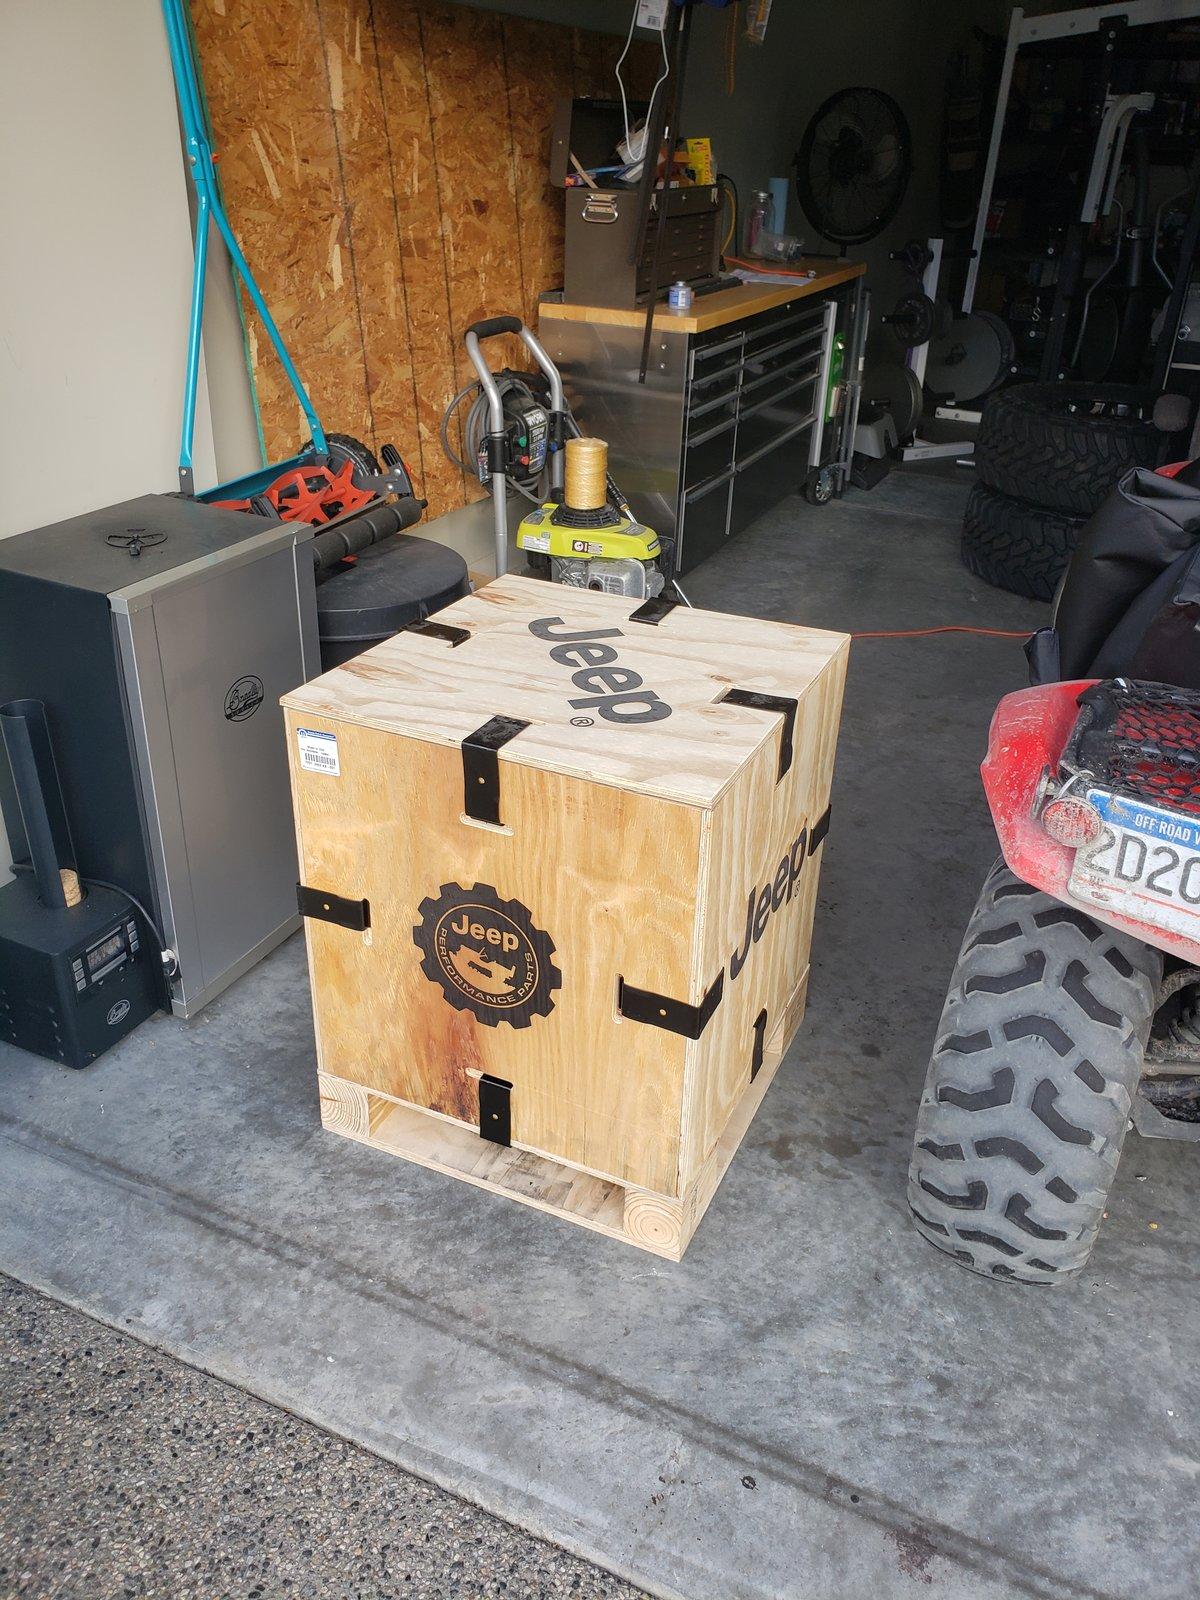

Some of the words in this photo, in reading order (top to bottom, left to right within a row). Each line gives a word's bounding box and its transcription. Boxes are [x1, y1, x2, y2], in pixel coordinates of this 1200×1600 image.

[528, 616, 672, 724] Jeep
[1134, 813, 1158, 830] OFF
[1158, 821, 1191, 842] ROAD
[451, 914, 519, 953] Jeep
[730, 827, 807, 980] Jeep
[436, 927, 516, 1004] PERFORMANCE
[517, 952, 534, 997] PARTS
